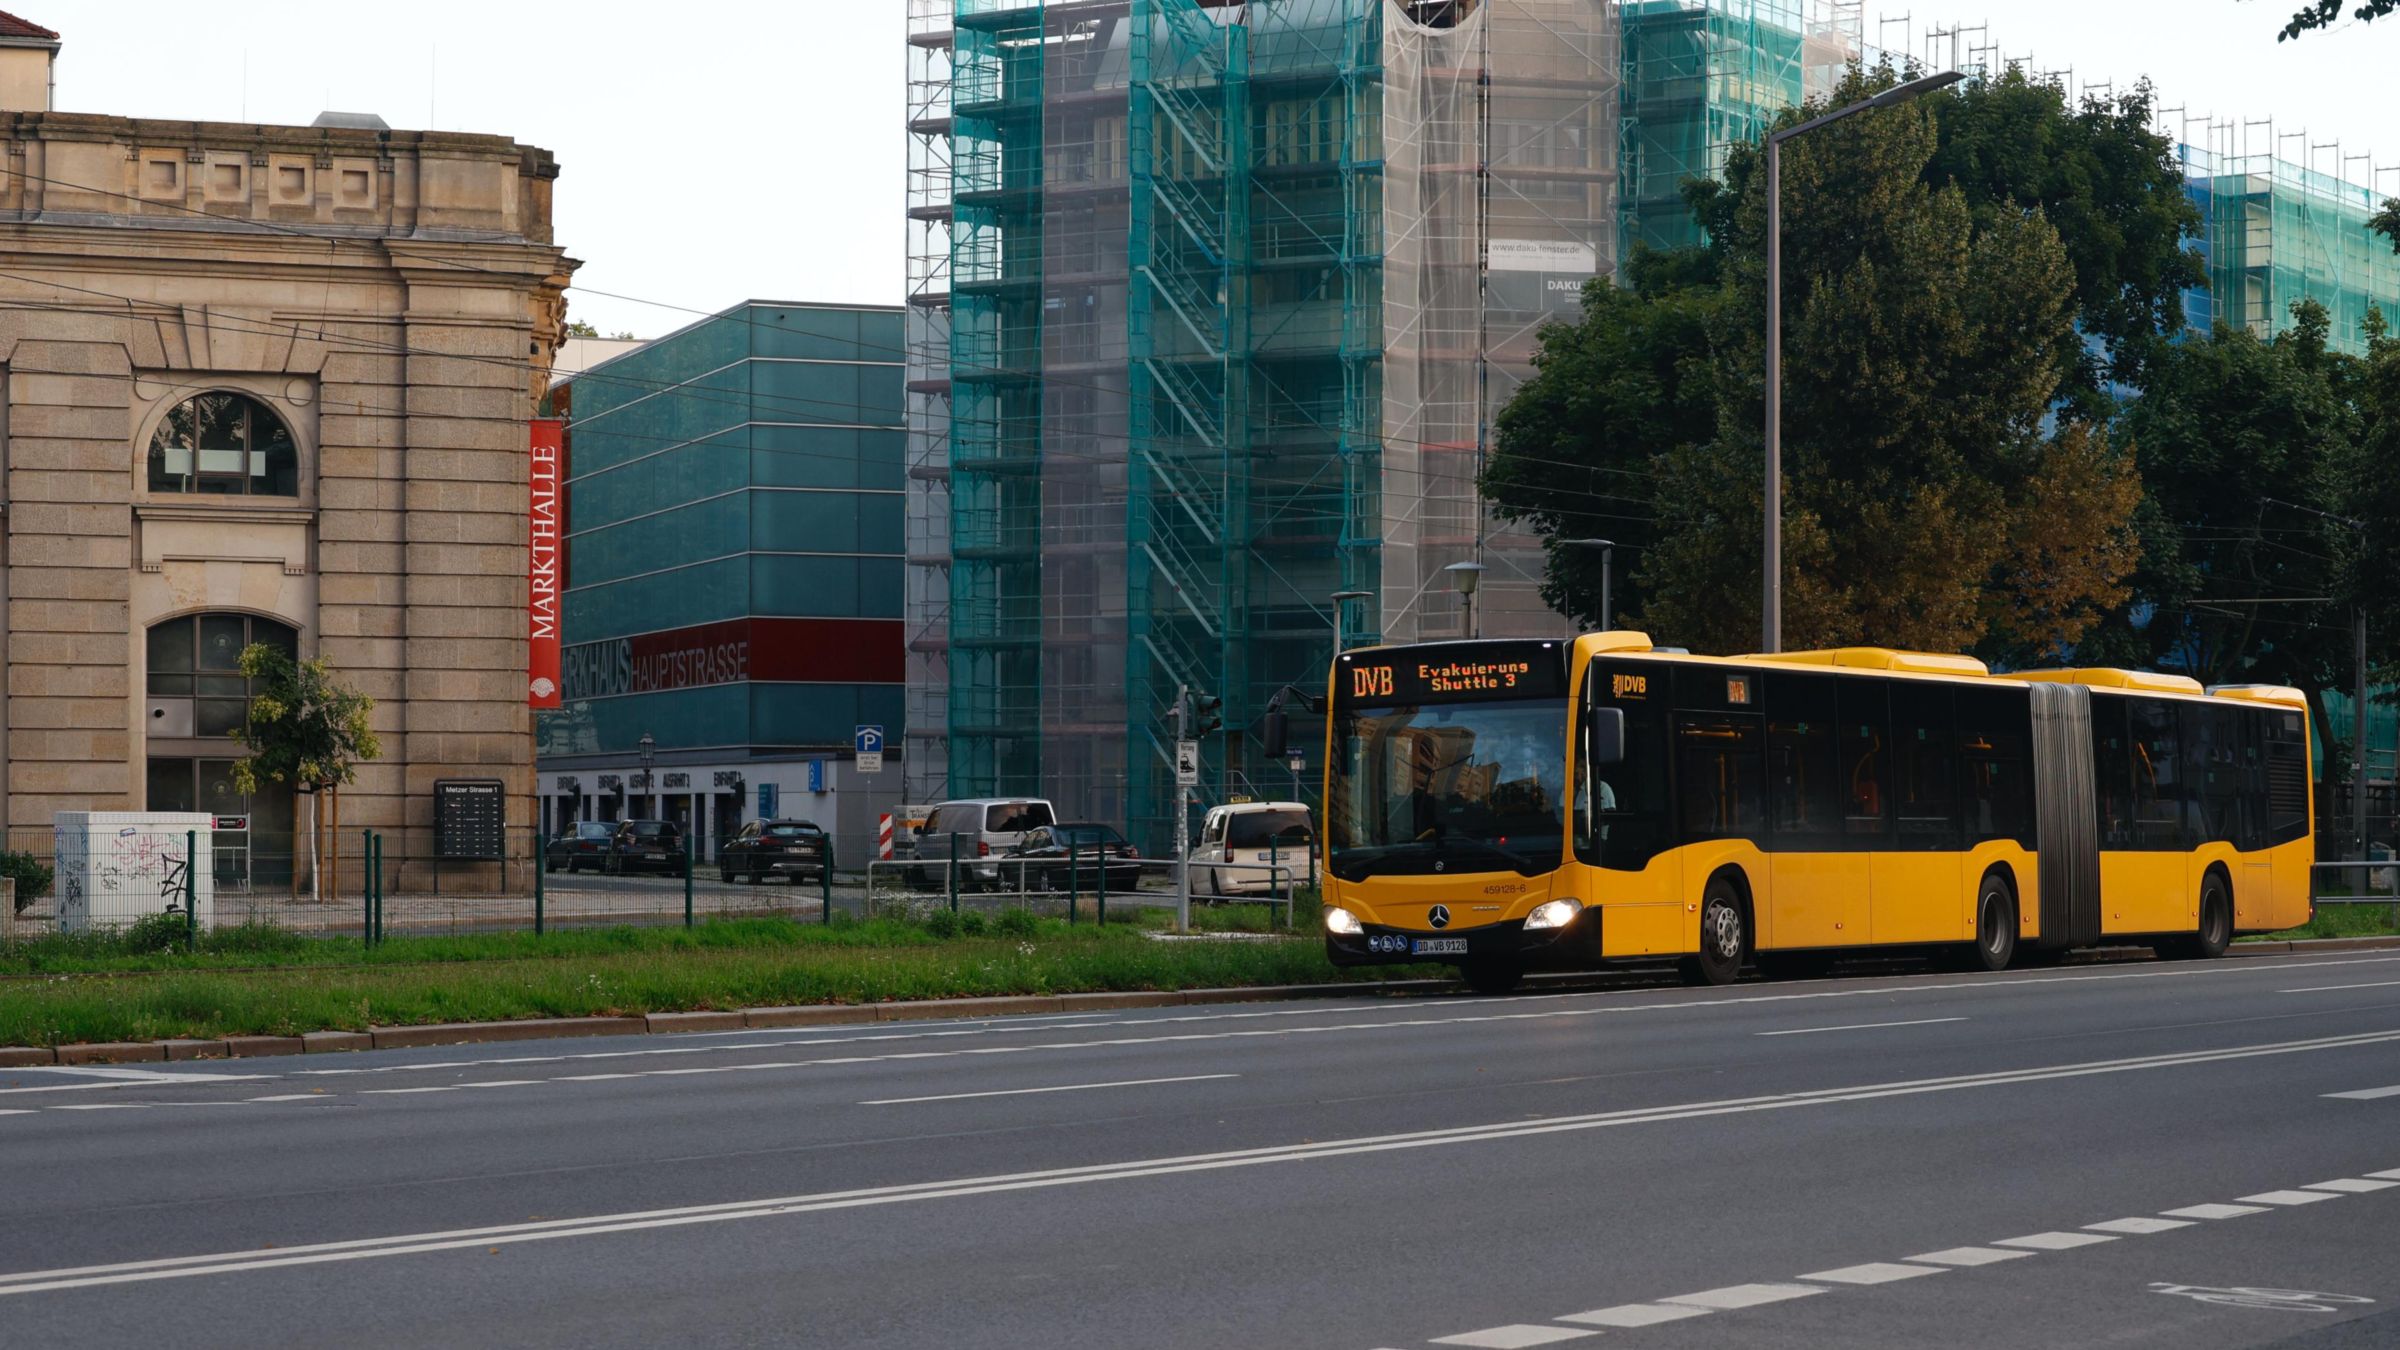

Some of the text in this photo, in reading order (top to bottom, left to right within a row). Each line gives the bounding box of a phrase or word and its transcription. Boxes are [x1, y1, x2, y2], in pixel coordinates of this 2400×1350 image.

[1547, 280, 1581, 291] DAKU
[532, 446, 555, 640] MARKTHALLE
[561, 639, 747, 699] ARKHAUS HAUPTSTRASSE
[1353, 662, 1528, 697] DVB Evakuierung
[1432, 674, 1516, 691] Shuttle 3
[1625, 675, 1646, 693] DVB
[1728, 681, 1746, 702] DVB
[864, 734, 876, 751] P
[1483, 884, 1526, 895] 459128-6
[1418, 940, 1466, 951] DD VB 9128
